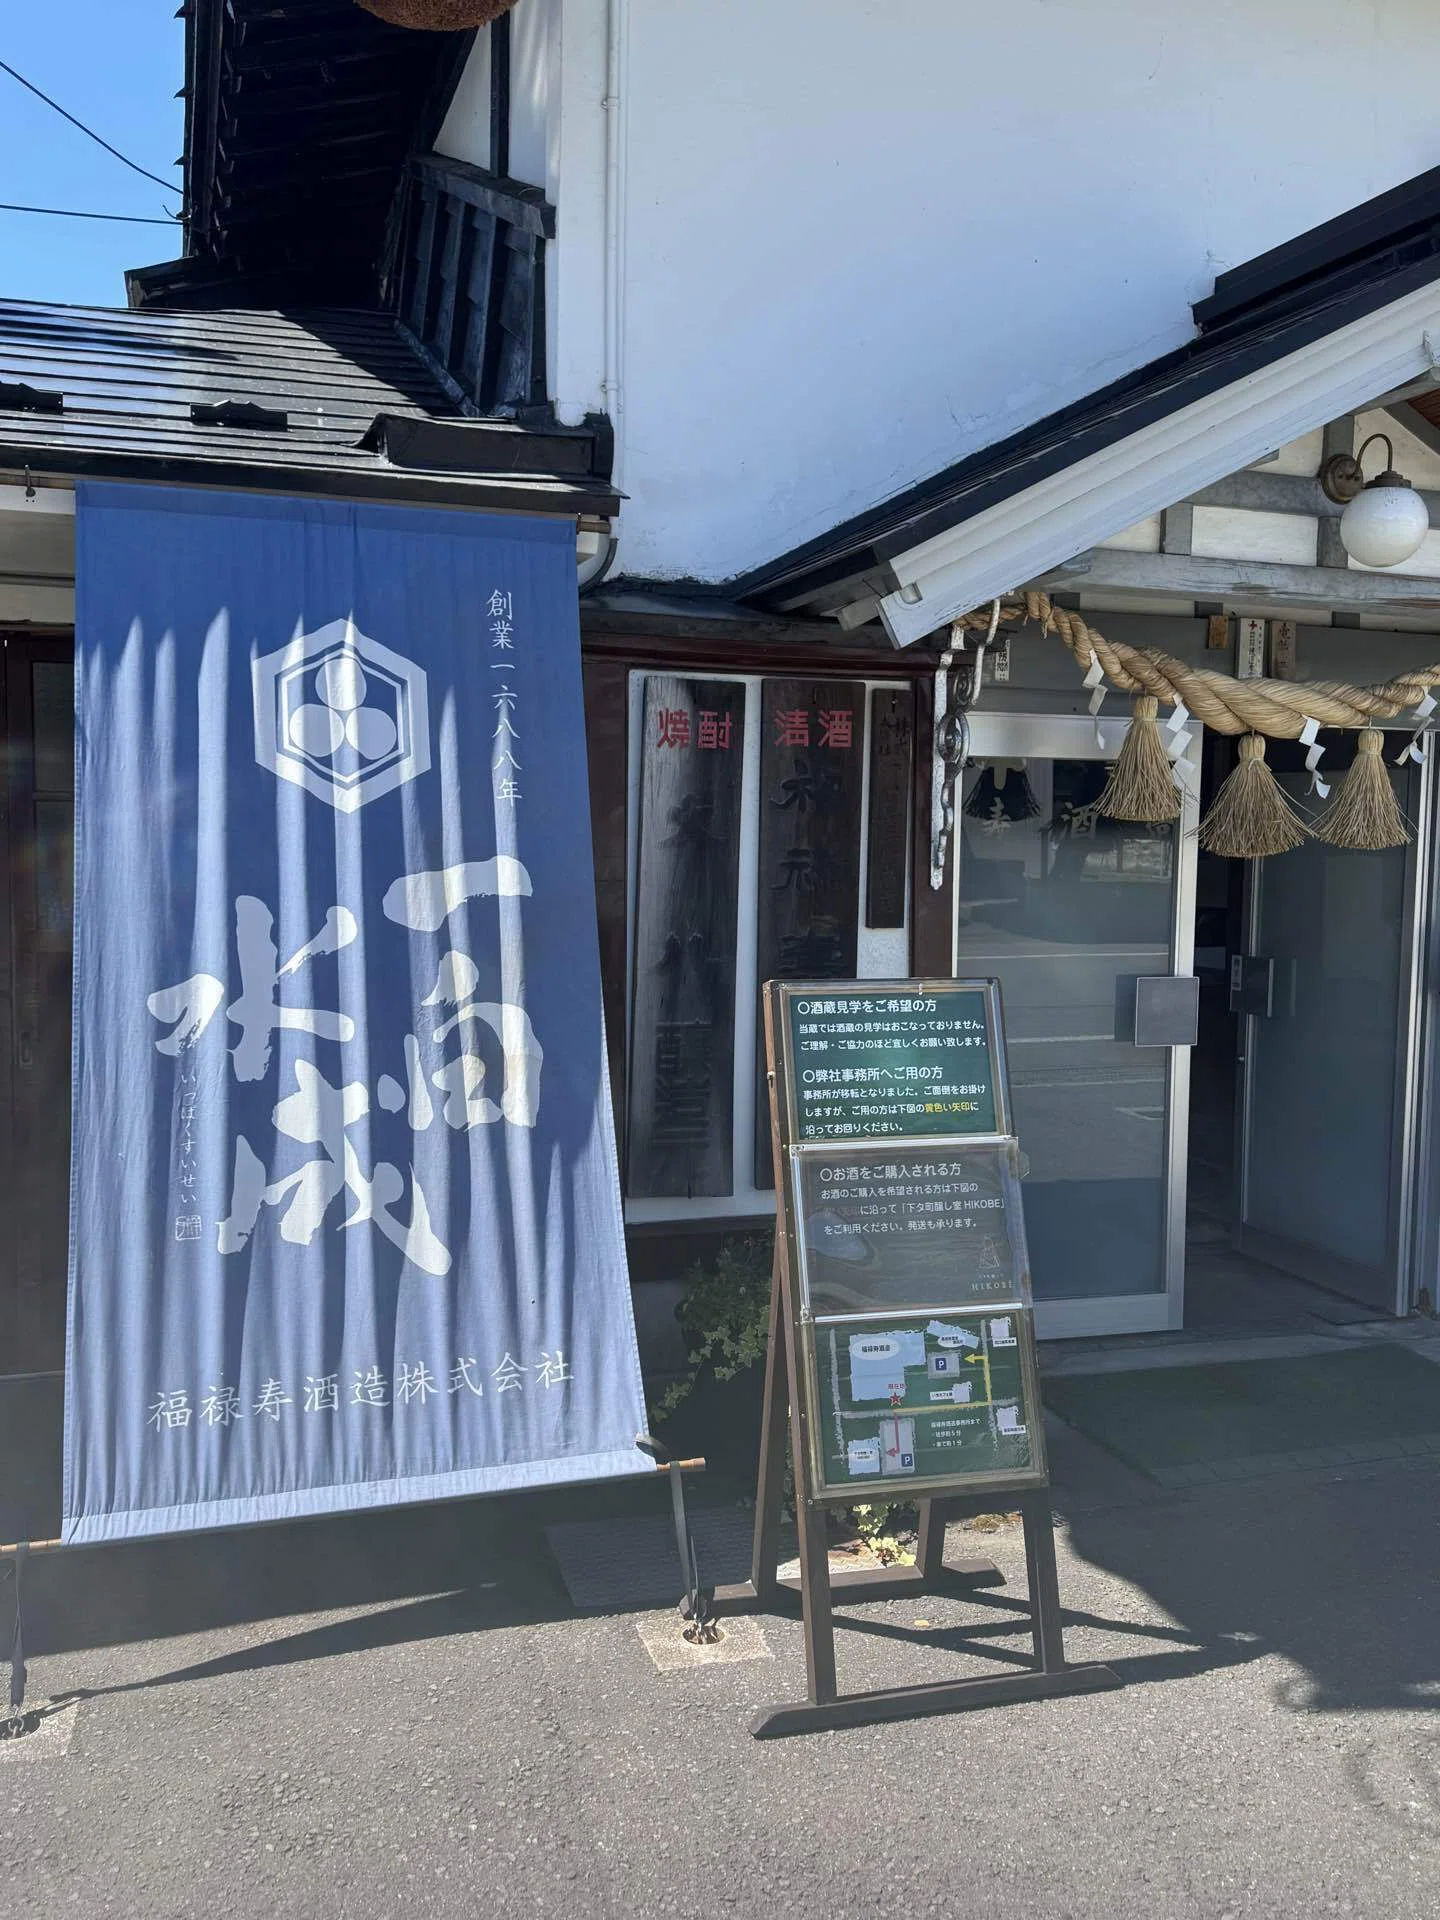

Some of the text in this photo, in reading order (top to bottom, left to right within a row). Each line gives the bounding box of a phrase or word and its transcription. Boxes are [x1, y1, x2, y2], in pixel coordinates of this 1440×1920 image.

[486, 588, 523, 806] 創業一六八八年
[656, 707, 733, 750] 焼酎
[773, 708, 853, 749] 清酒
[799, 1020, 986, 1035] 当蔵では酒蔵の見学はおこなっておりません。
[800, 1037, 987, 1051] ご理解・ご協力のほど宜しくお願い致します。
[805, 1122, 904, 1135] 沿ってお回りください。
[821, 1183, 978, 1199] お酒のご購入を希望される方は下図の
[824, 1218, 978, 1235] をご利用ください。発送も承ります。
[147, 1347, 575, 1434] 福禄寿酒造株式会社
